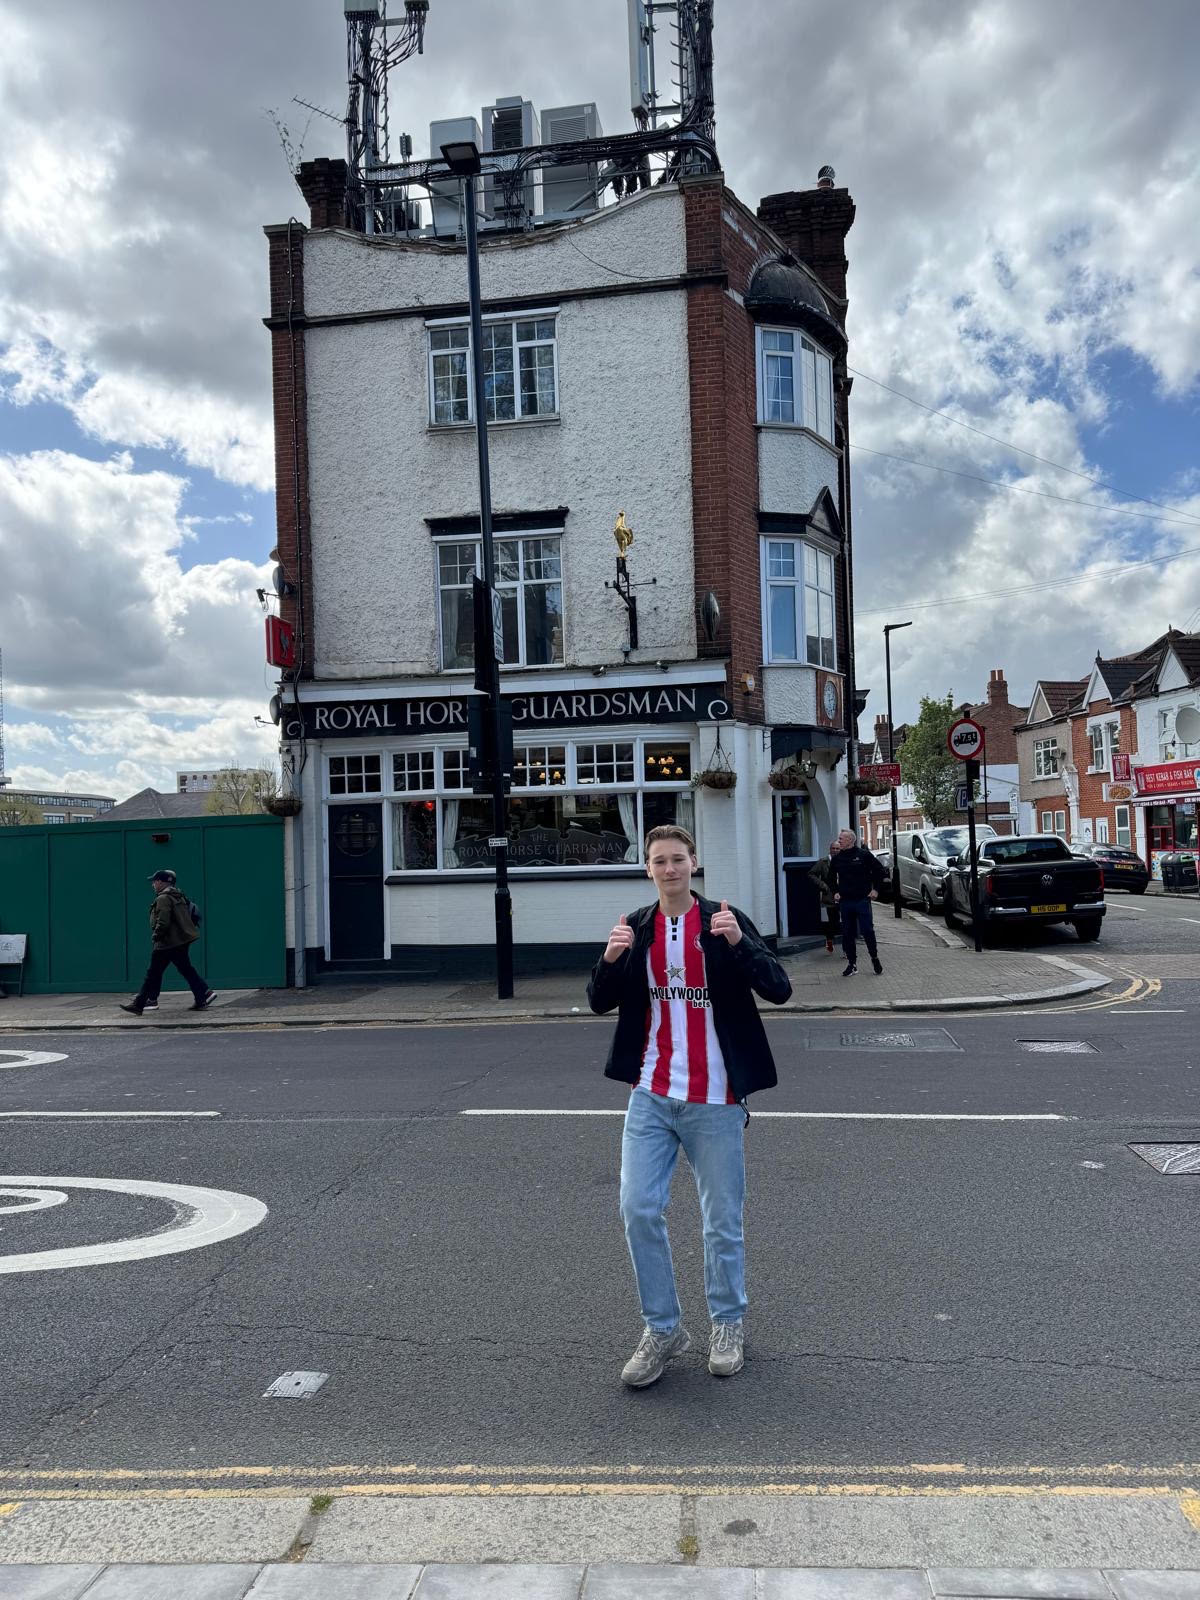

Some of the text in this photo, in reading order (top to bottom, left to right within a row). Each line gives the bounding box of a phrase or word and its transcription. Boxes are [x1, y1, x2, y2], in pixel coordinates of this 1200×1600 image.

[314, 688, 697, 730] ROYAL HOR GUARDSMAN
[530, 833, 549, 842] THE
[459, 846, 496, 858] ROYAL
[548, 842, 624, 855] GUARDSMAN
[693, 1000, 711, 1008] bets
